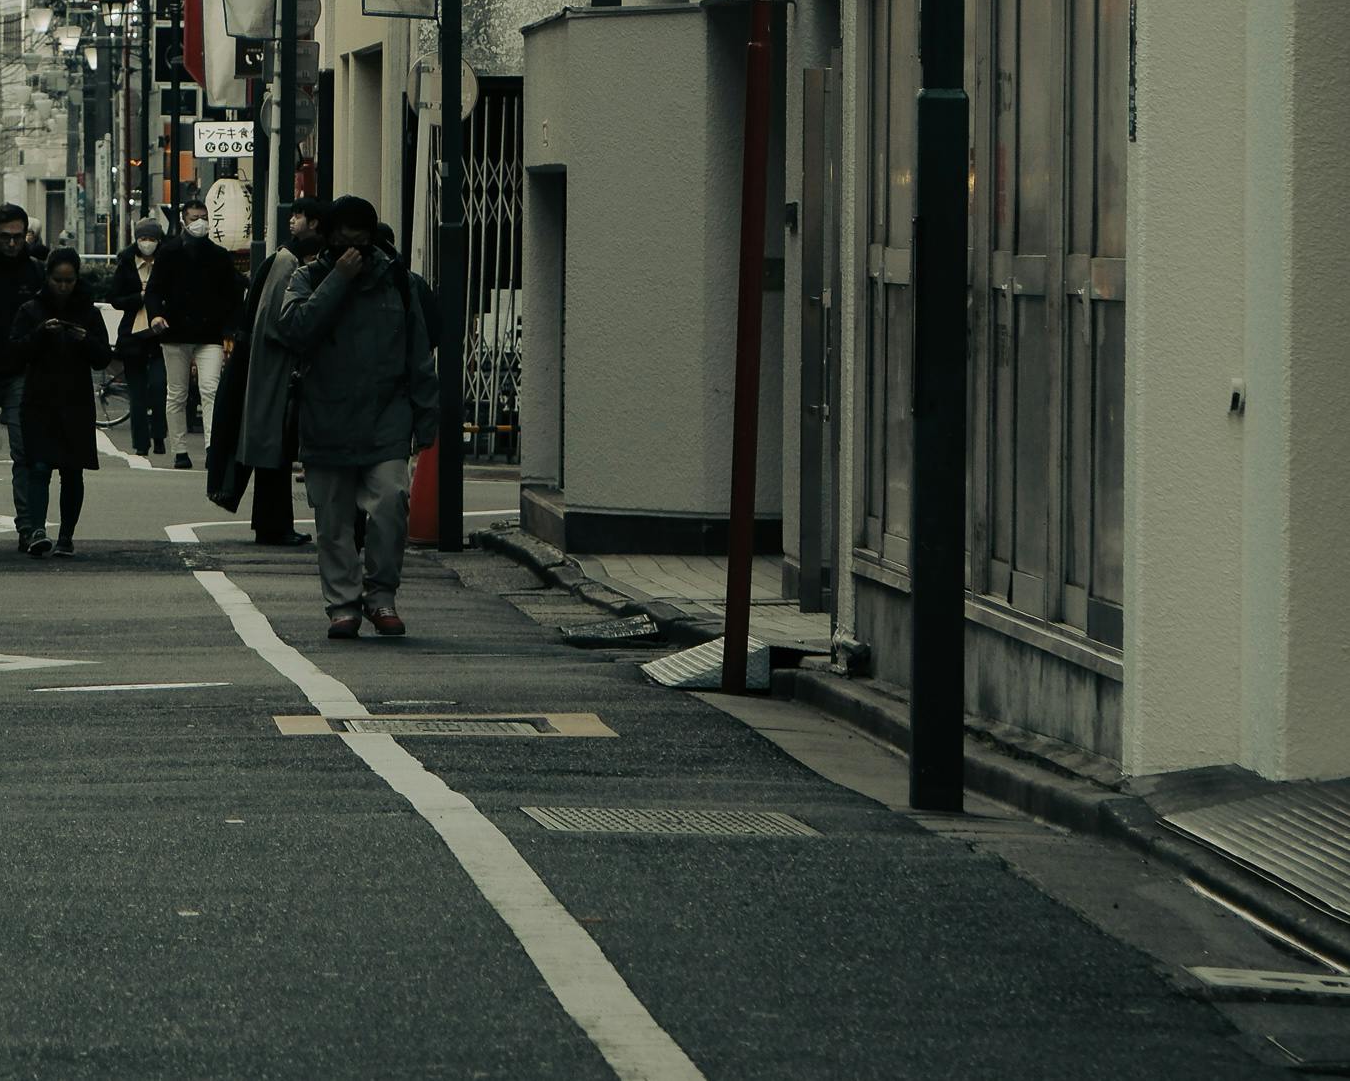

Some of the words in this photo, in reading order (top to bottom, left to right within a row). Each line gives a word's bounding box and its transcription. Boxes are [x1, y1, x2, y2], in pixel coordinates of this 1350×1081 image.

[198, 127, 254, 140] トンテキ食
